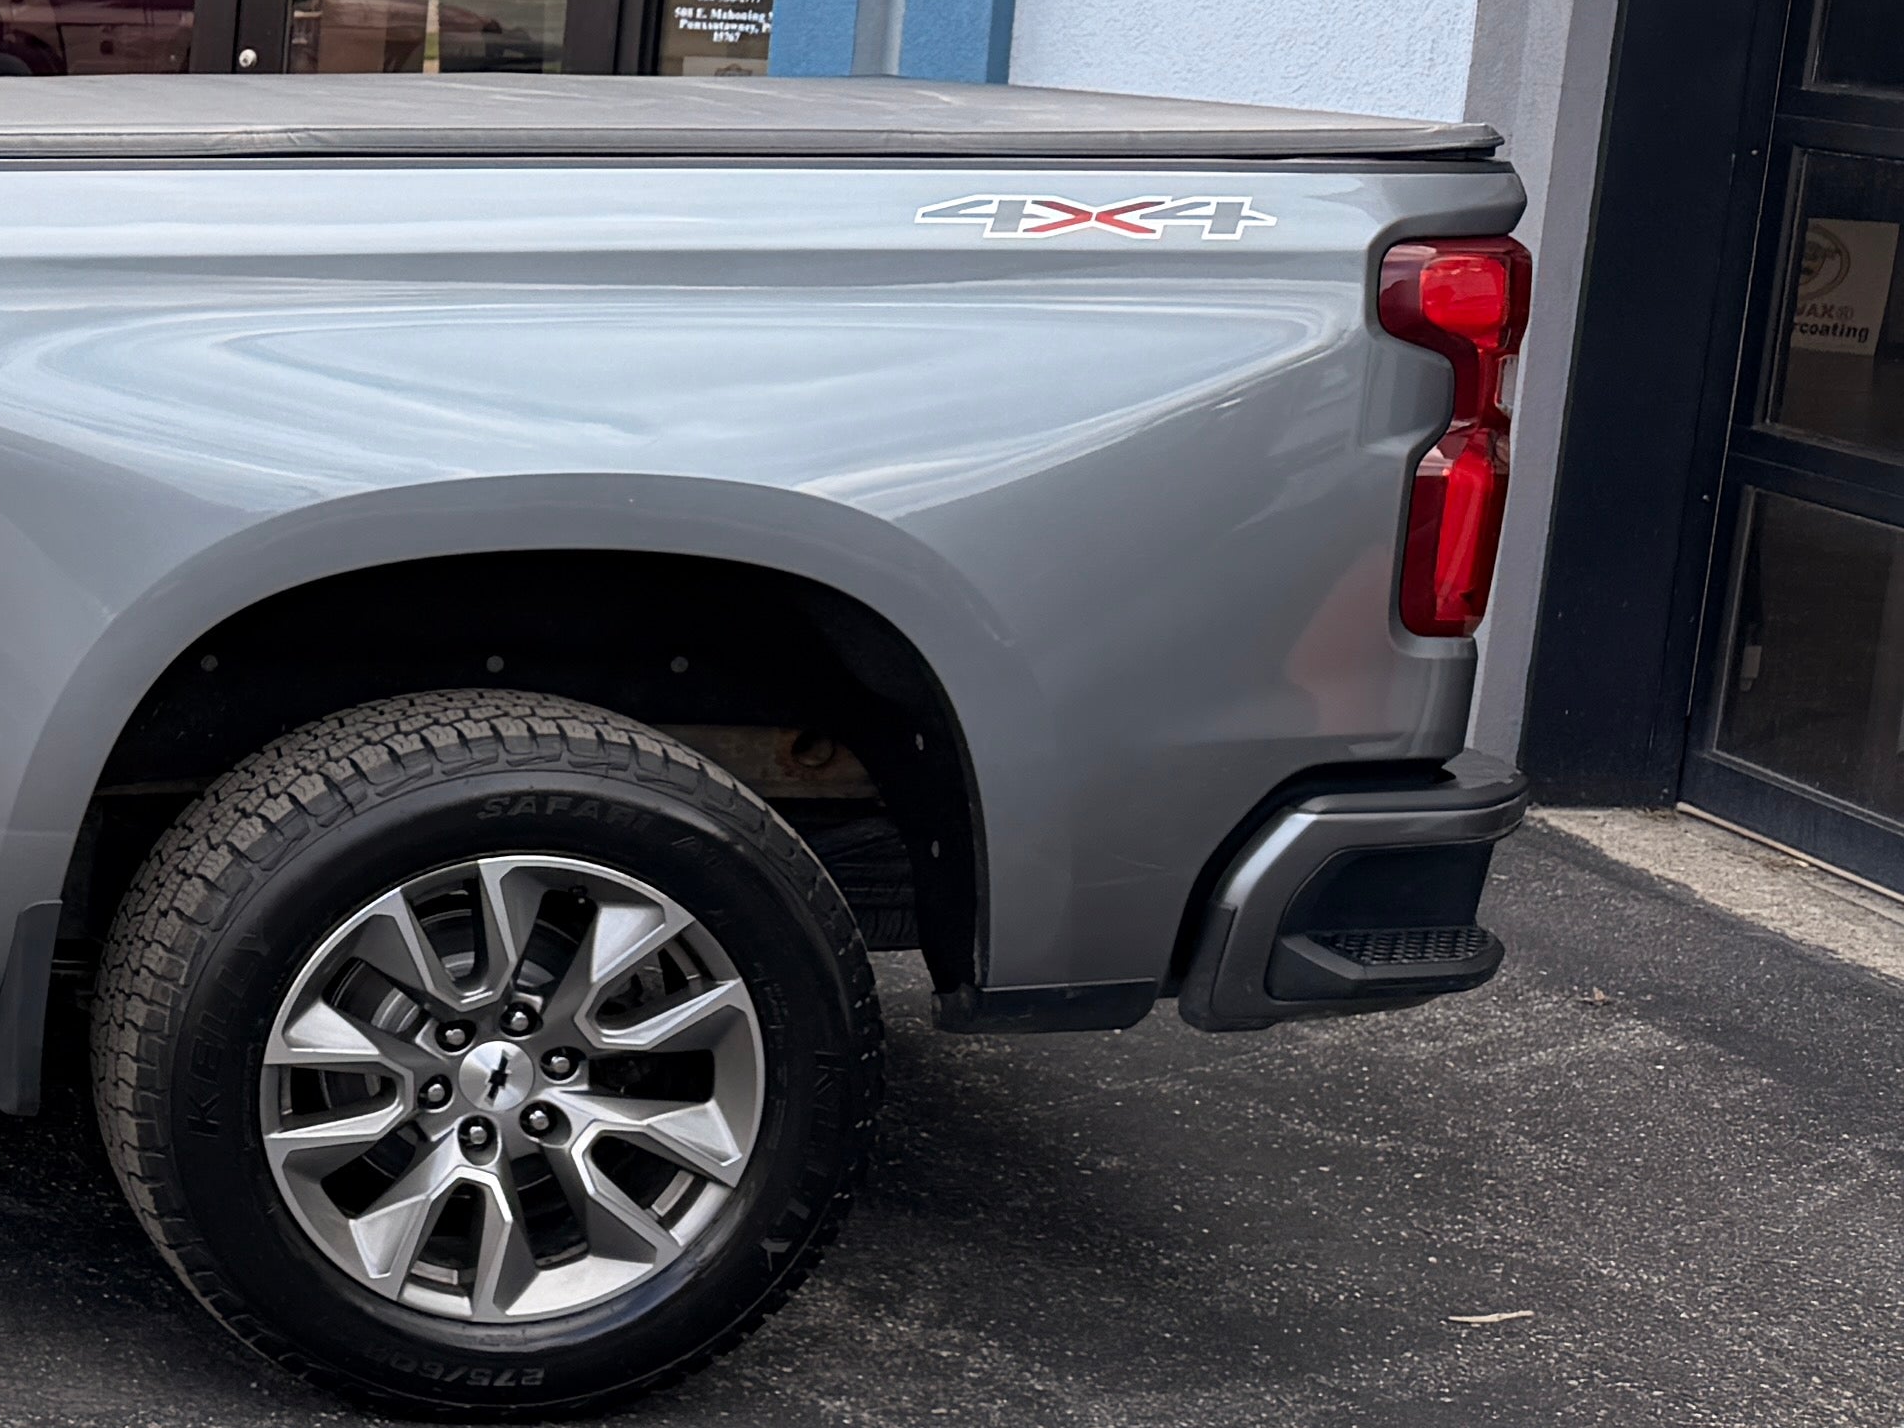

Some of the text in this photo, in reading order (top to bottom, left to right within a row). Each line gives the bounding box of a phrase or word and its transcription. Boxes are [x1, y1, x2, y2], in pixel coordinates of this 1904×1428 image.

[695, 7, 708, 20] E.
[710, 9, 766, 23] Mahoning
[475, 793, 654, 832] SAFARI
[183, 924, 273, 1139] KELLY
